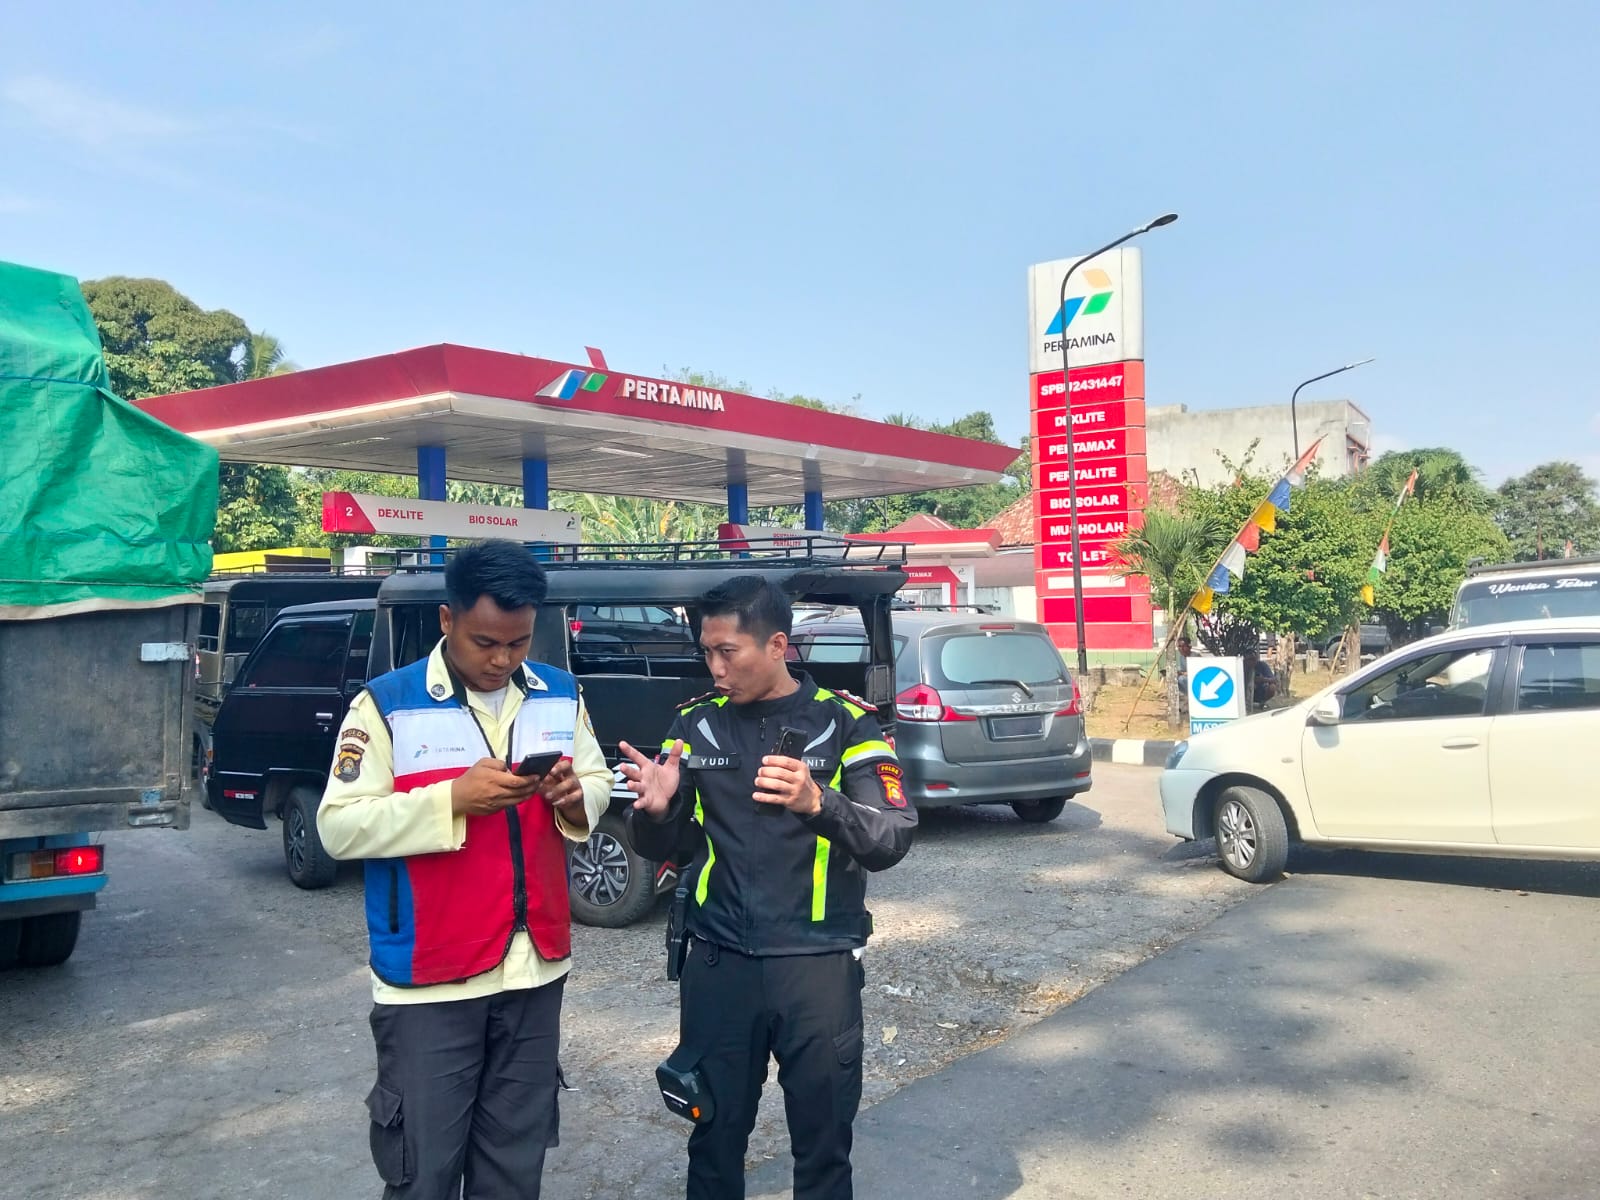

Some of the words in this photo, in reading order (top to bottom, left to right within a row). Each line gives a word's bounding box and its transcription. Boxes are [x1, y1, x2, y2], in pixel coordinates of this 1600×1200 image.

[1044, 332, 1116, 352] PERTAMINA
[622, 378, 725, 412] PERTAMINA
[1049, 466, 1117, 482] PERTALITE
[1050, 498, 1071, 509] BIO
[1075, 494, 1119, 508] SOLAR
[346, 507, 353, 517] 2
[378, 508, 424, 520] DEXLITE
[469, 515, 485, 524] BIO
[487, 516, 518, 527] SOLAR
[1050, 521, 1124, 537] MUHOLAH
[1058, 551, 1109, 563] TOLET
[700, 757, 729, 766] YUDI
[806, 759, 827, 767] NIT
